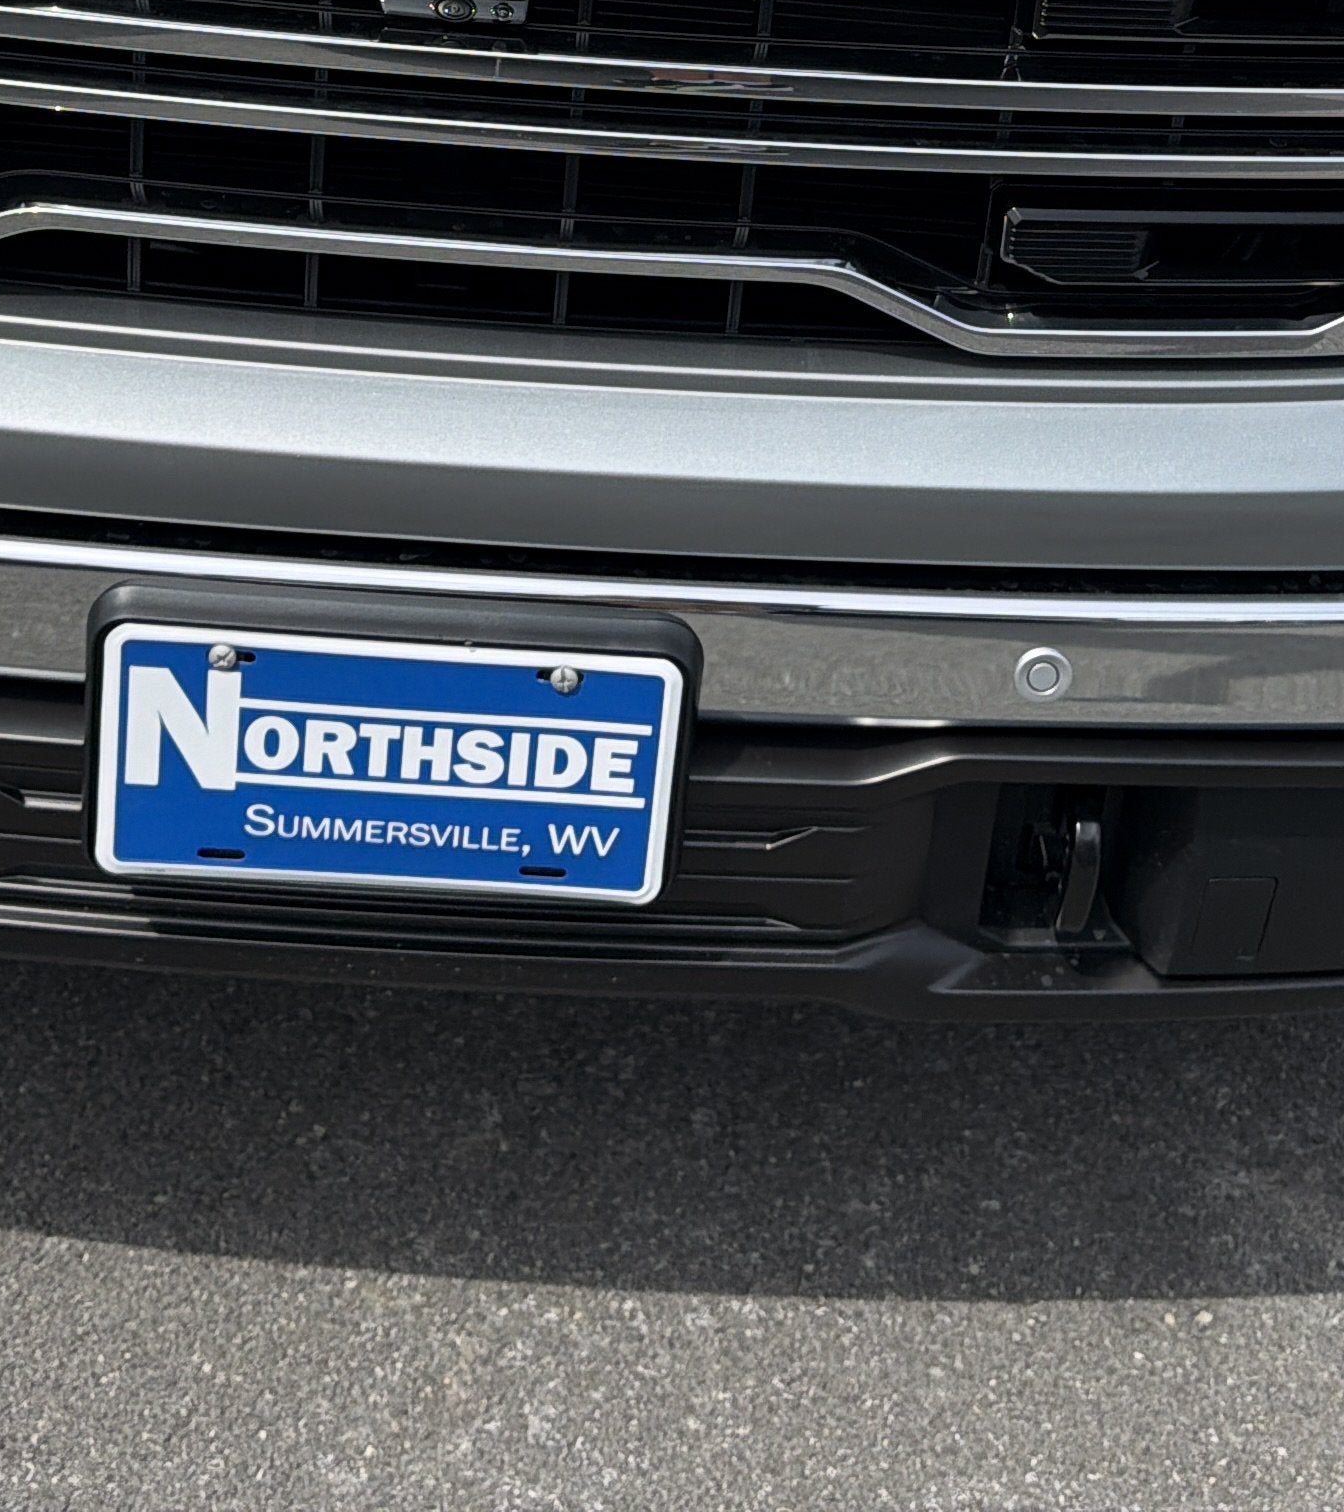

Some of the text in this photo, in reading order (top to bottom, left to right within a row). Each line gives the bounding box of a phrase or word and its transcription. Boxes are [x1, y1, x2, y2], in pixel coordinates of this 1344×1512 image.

[124, 664, 639, 794] NORTHSIDE
[243, 803, 620, 858] SUMMERSVILLE, WV
